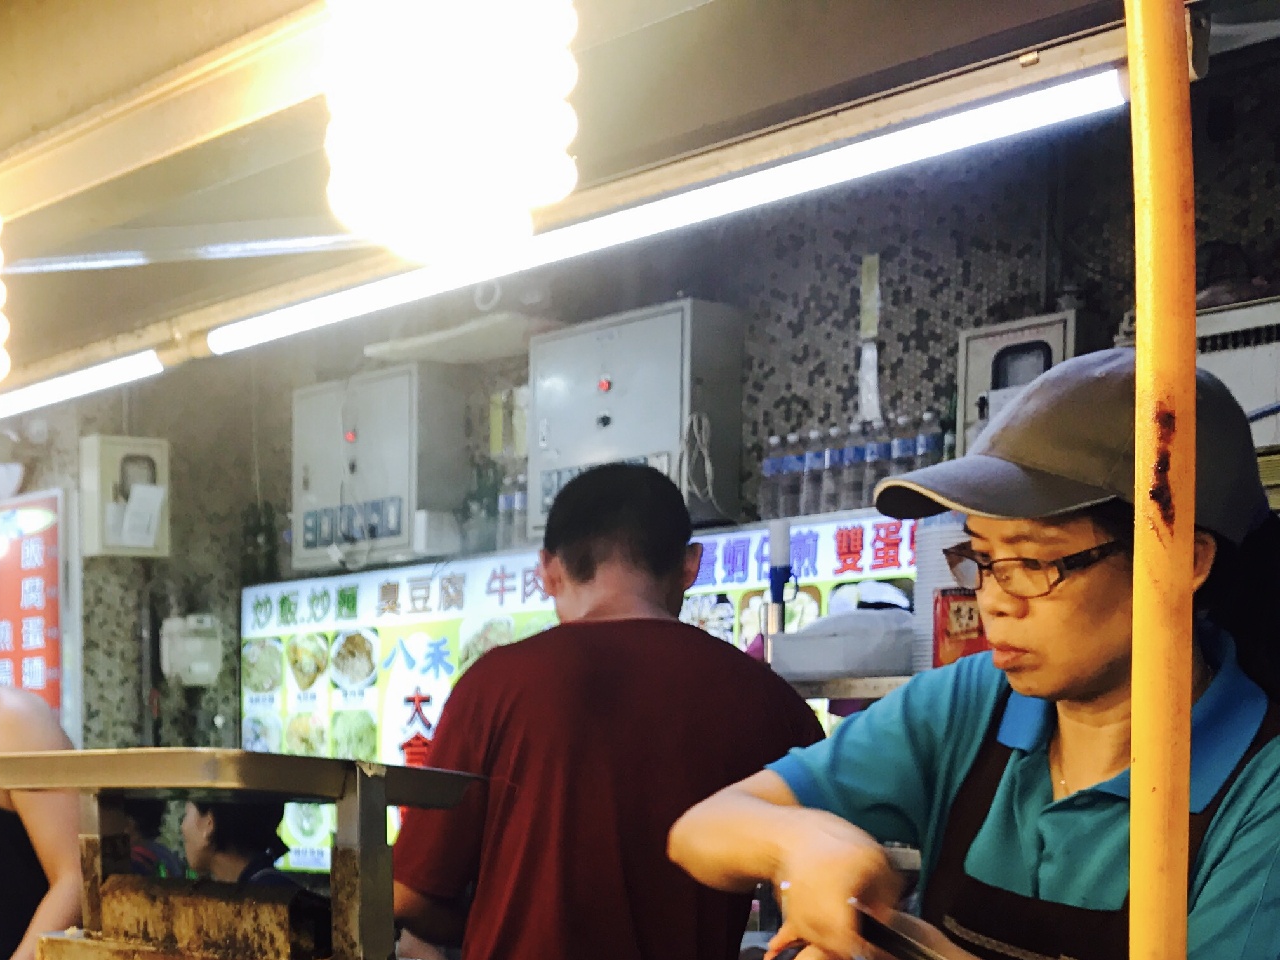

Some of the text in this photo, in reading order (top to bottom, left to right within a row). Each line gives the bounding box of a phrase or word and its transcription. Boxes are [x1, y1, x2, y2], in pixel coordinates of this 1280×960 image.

[833, 520, 917, 574] 雙蛋
[376, 571, 467, 616] 臭豆腐
[382, 637, 456, 680] 八禾
